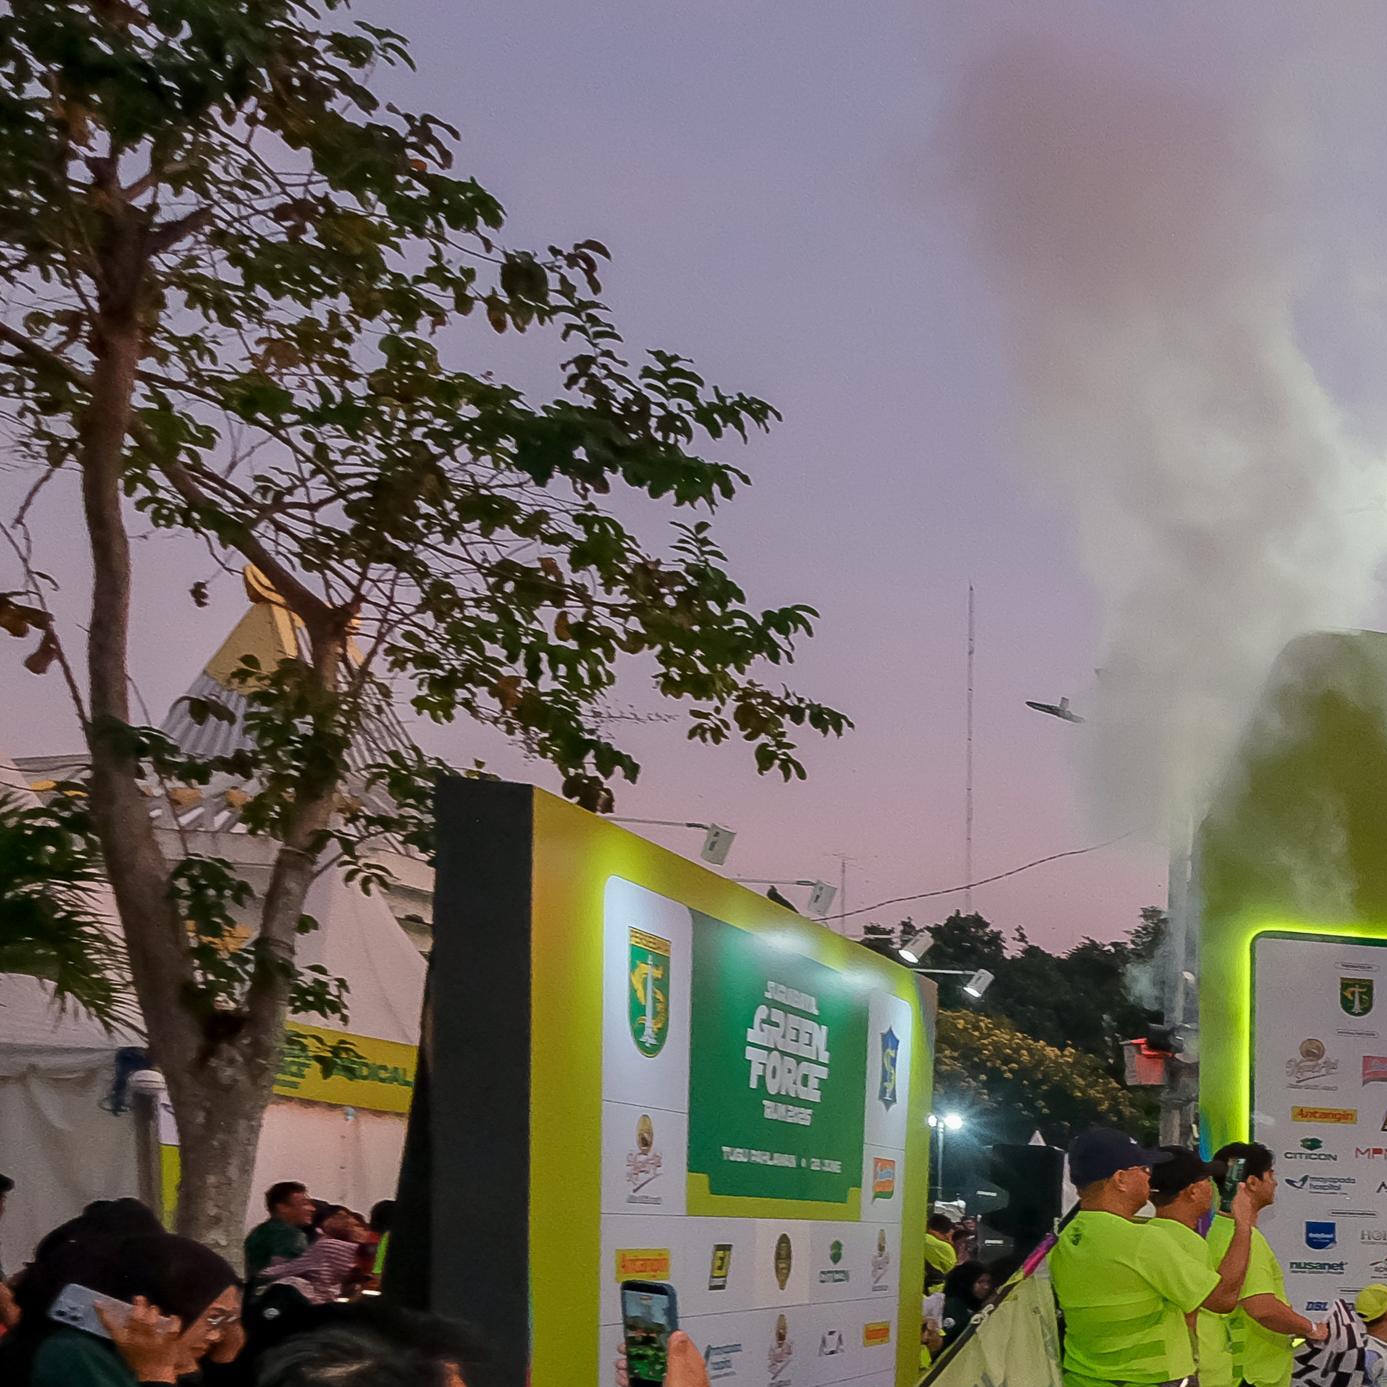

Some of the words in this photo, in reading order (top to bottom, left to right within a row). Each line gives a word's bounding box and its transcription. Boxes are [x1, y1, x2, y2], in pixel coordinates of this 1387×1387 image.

[746, 1005, 830, 1063] GREEN
[745, 1046, 829, 1102] FORCE
[1298, 1108, 1354, 1123] Antangin
[1284, 1151, 1337, 1161] CITICON
[1289, 1260, 1345, 1271] nusanet
